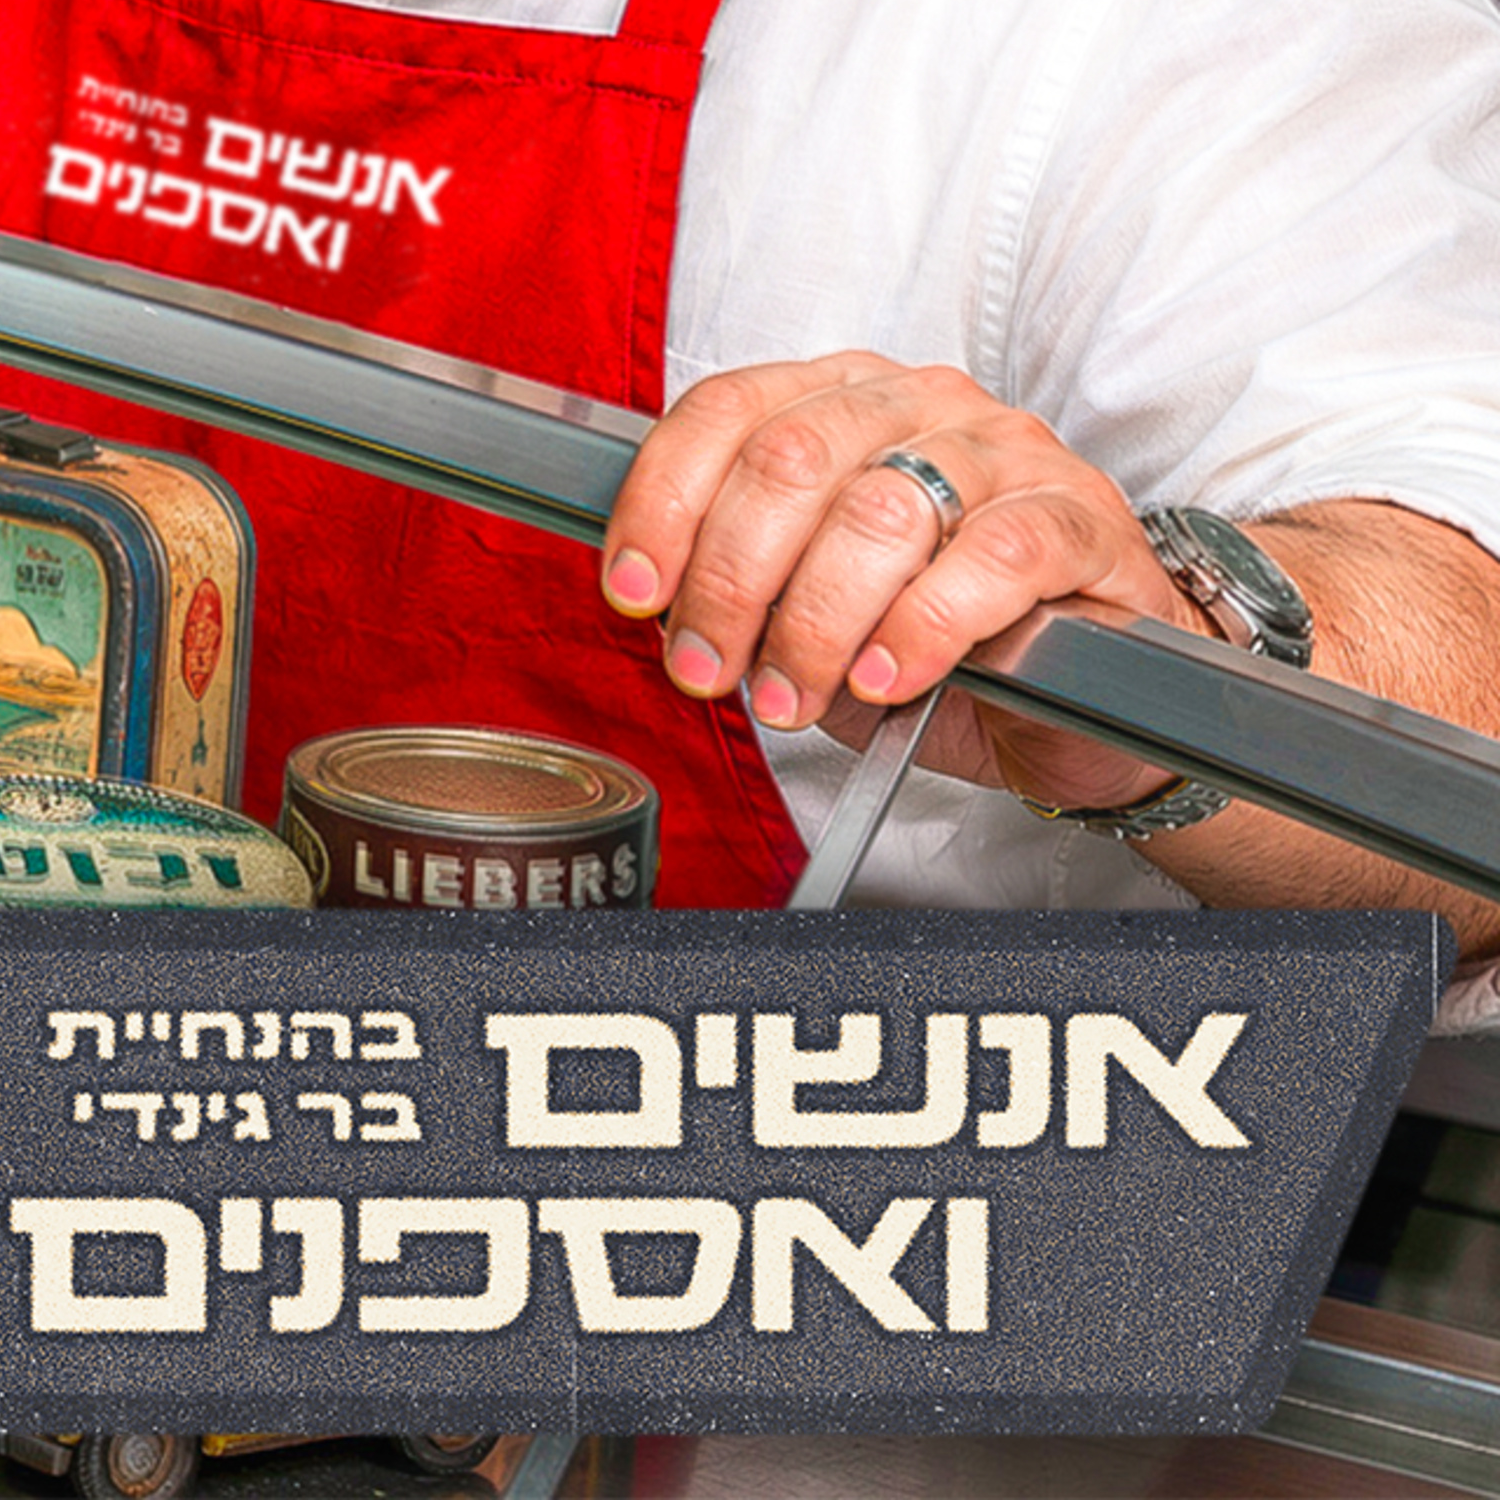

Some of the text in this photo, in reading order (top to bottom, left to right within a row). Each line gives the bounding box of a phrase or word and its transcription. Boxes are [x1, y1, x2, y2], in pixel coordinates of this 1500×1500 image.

[43, 143, 351, 272] ואספנים
[204, 116, 453, 226] אנשים
[354, 839, 639, 911] LIEBERS
